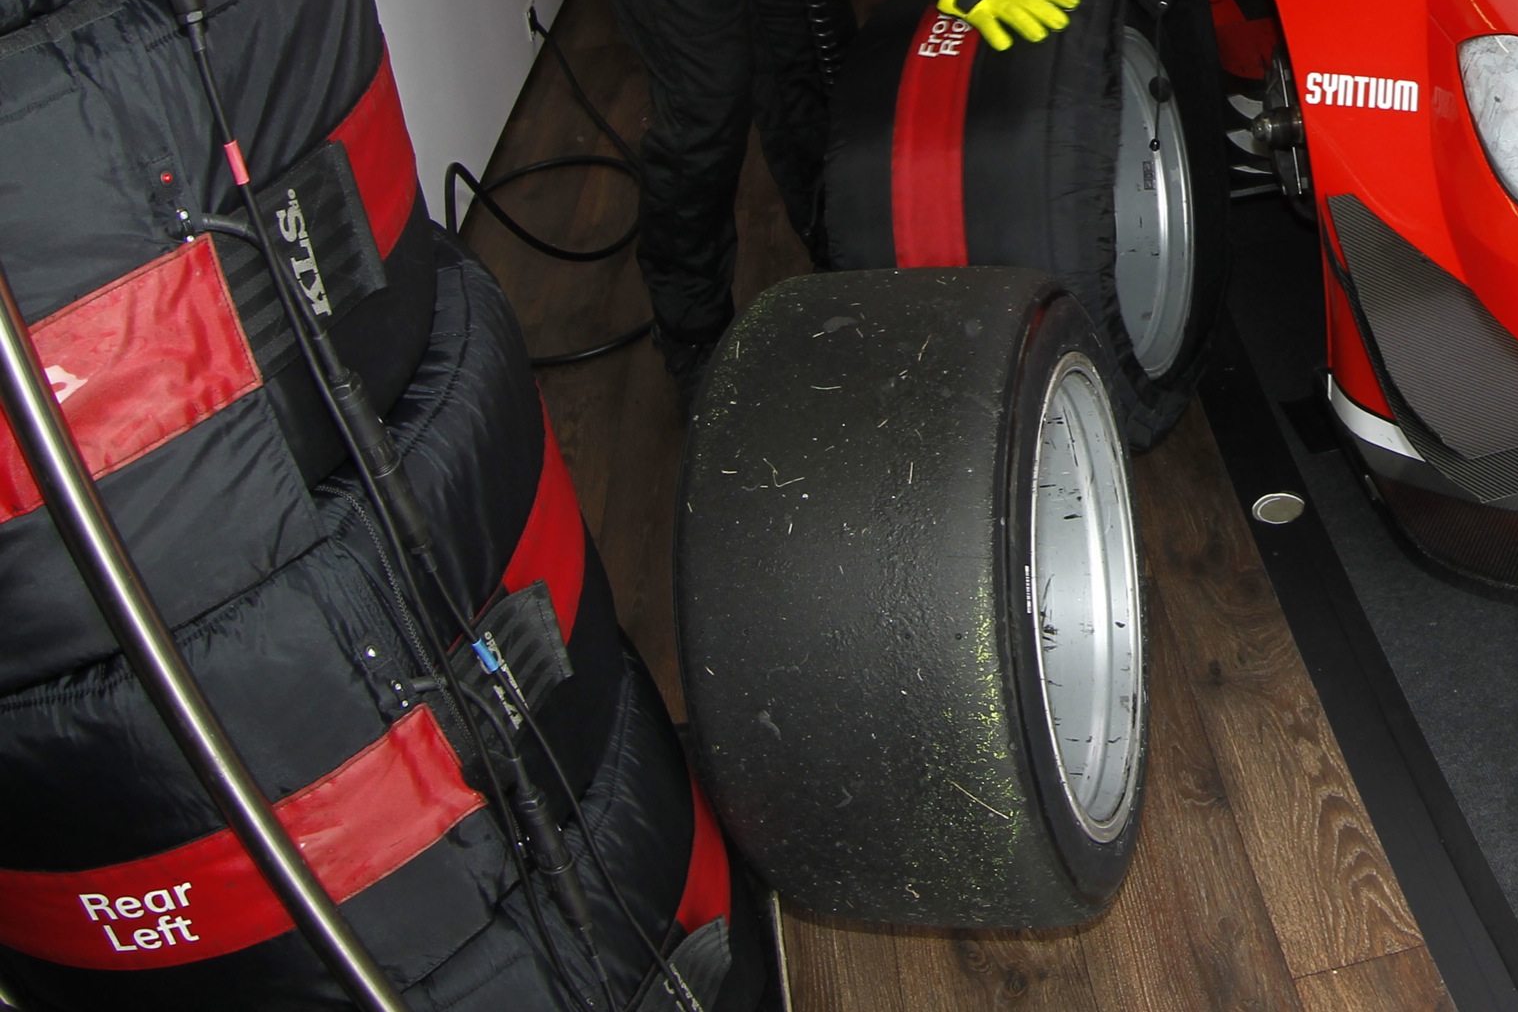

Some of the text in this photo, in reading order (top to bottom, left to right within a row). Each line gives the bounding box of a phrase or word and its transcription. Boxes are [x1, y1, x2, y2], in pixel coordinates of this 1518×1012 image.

[918, 12, 953, 58] Fro
[940, 16, 973, 57] Rig
[1305, 71, 1419, 112] SYNTIUM
[79, 882, 192, 921] Rear
[103, 915, 200, 951] Left
